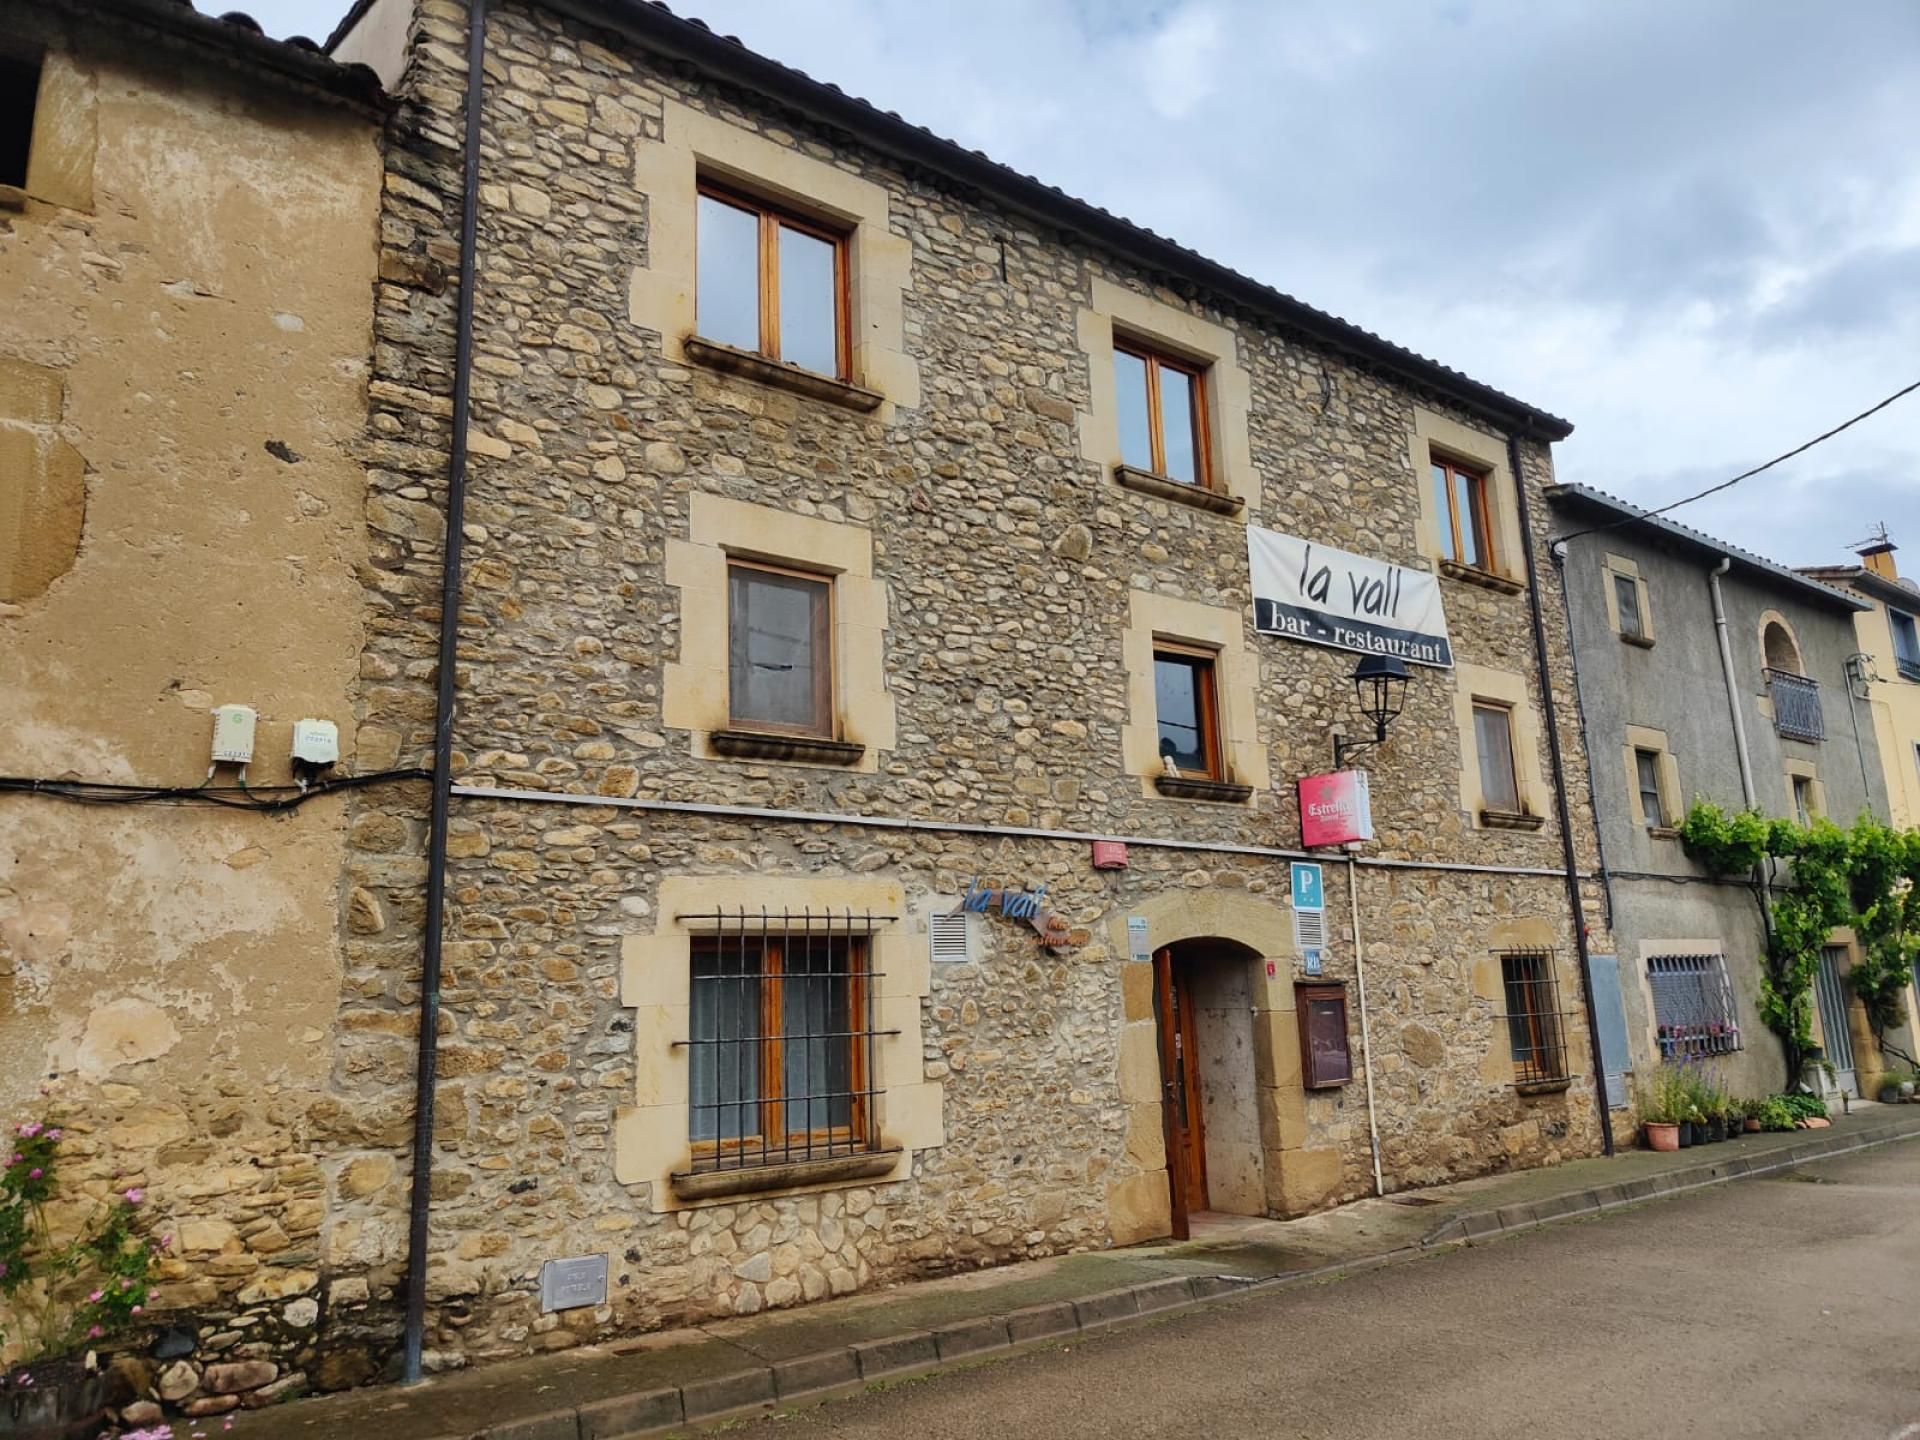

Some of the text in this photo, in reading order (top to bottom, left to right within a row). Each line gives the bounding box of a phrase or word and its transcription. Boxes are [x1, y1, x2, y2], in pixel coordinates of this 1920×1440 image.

[1299, 543, 1401, 619] la vall
[1270, 602, 1311, 637] bar
[1333, 626, 1442, 663] restaurant
[964, 875, 993, 913] la
[1300, 870, 1313, 894] P
